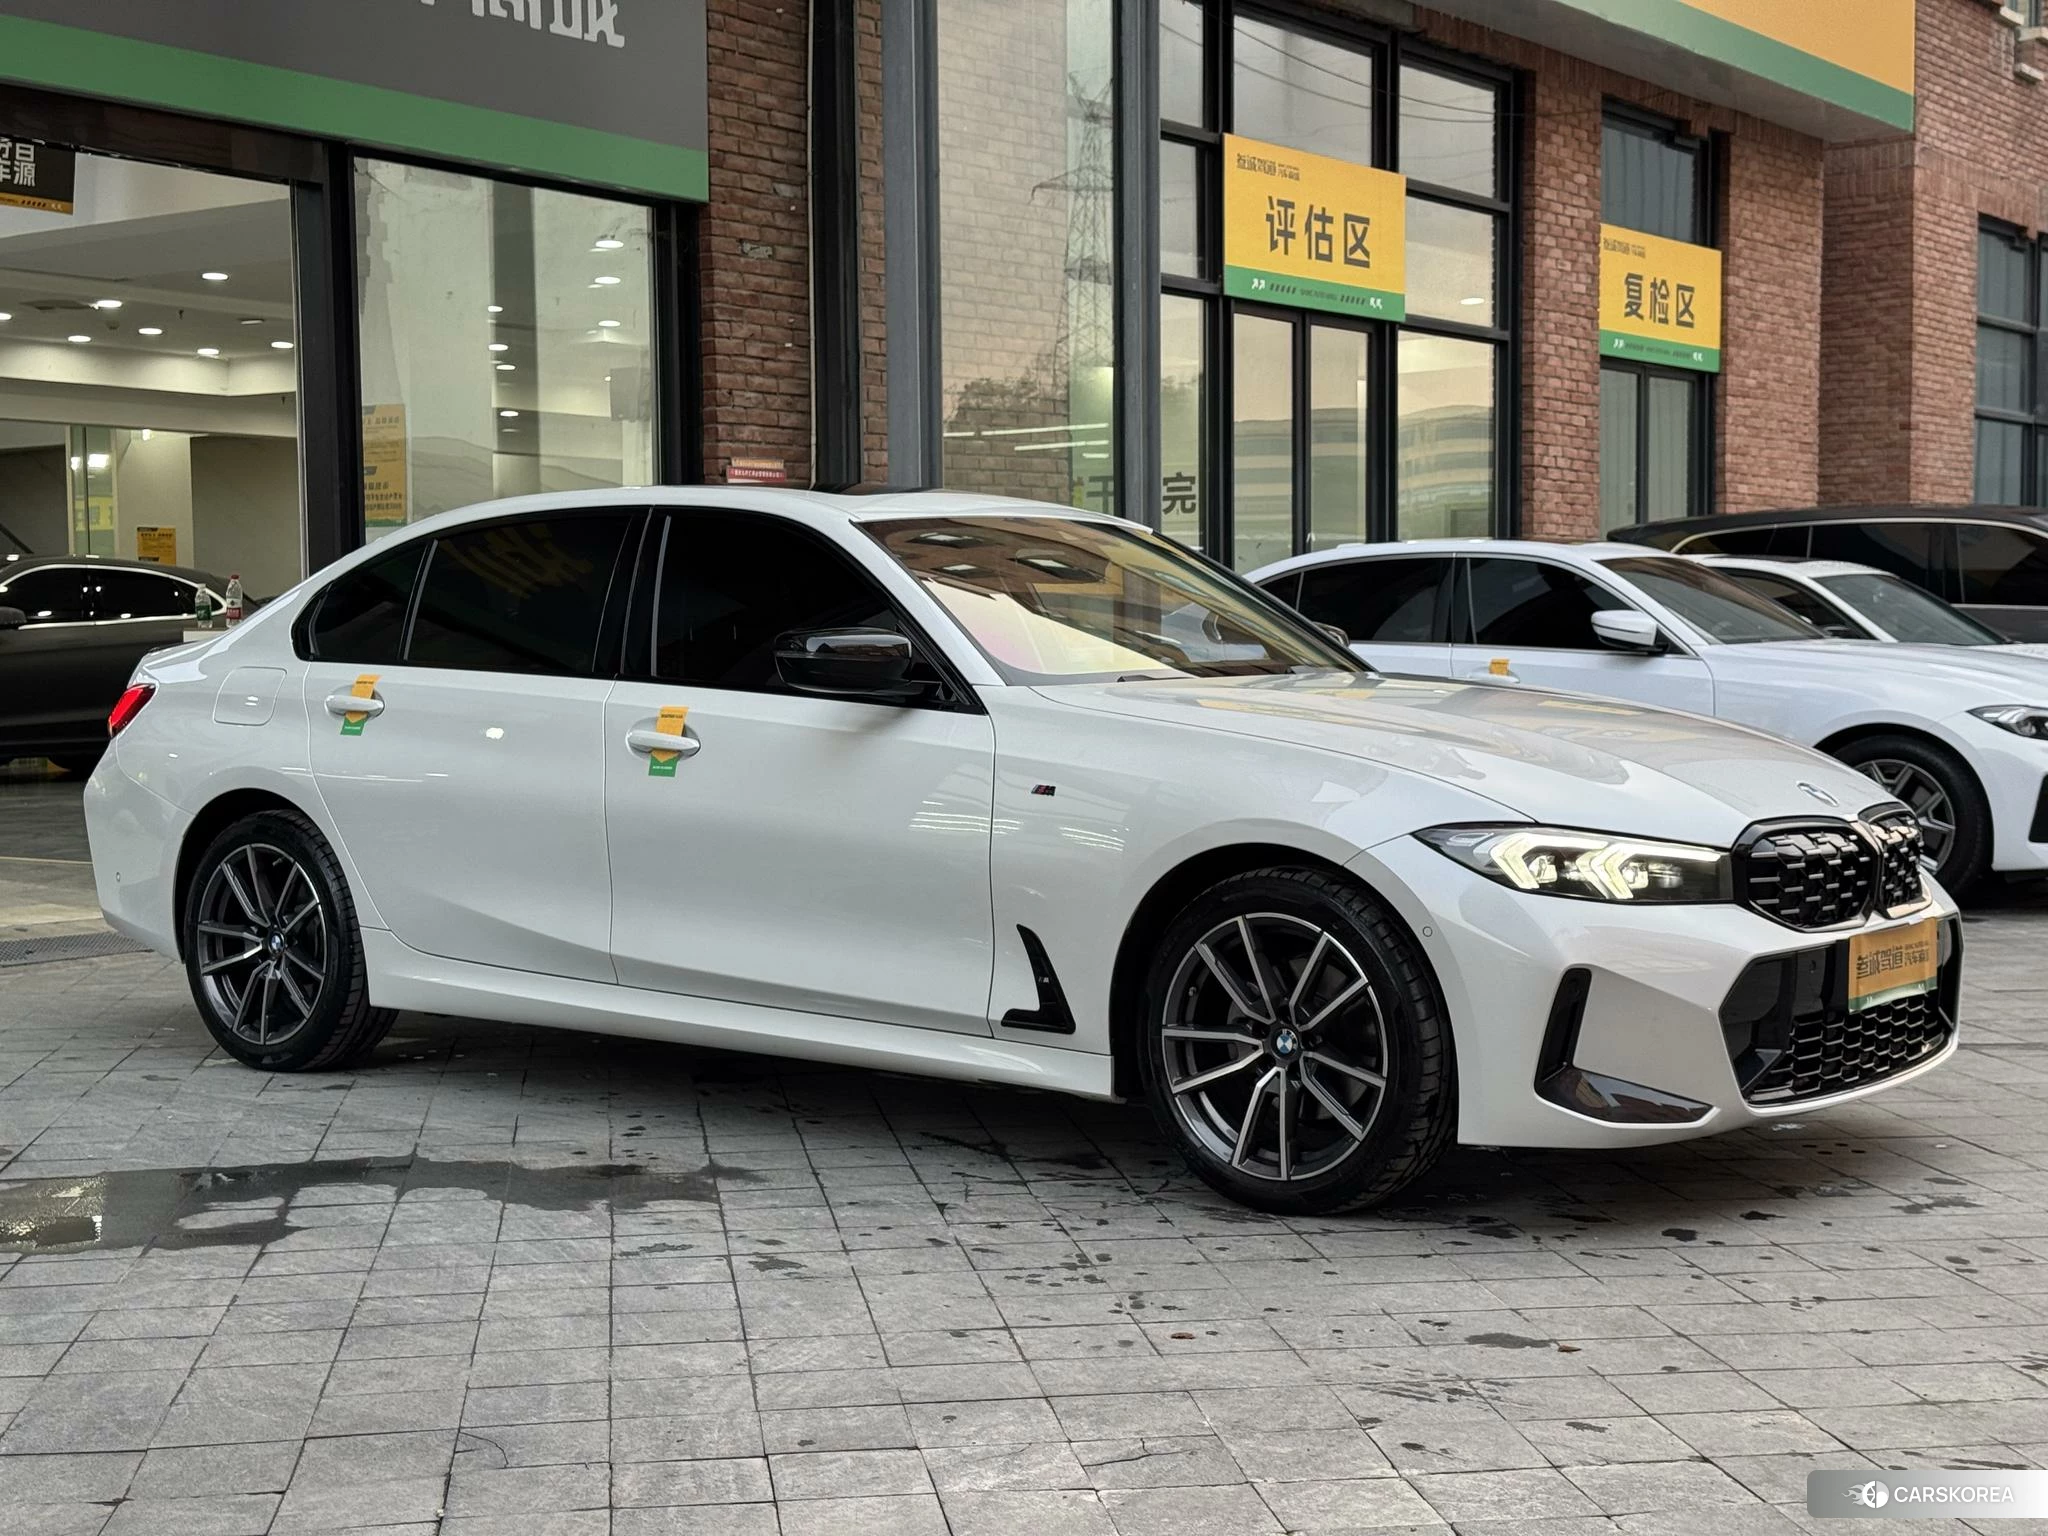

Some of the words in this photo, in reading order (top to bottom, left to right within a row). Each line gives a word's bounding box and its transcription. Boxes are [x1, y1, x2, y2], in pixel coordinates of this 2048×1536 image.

[1265, 195, 1370, 269] 评估区
[1624, 272, 1695, 329] 复检区
[1162, 471, 1197, 516] 完
